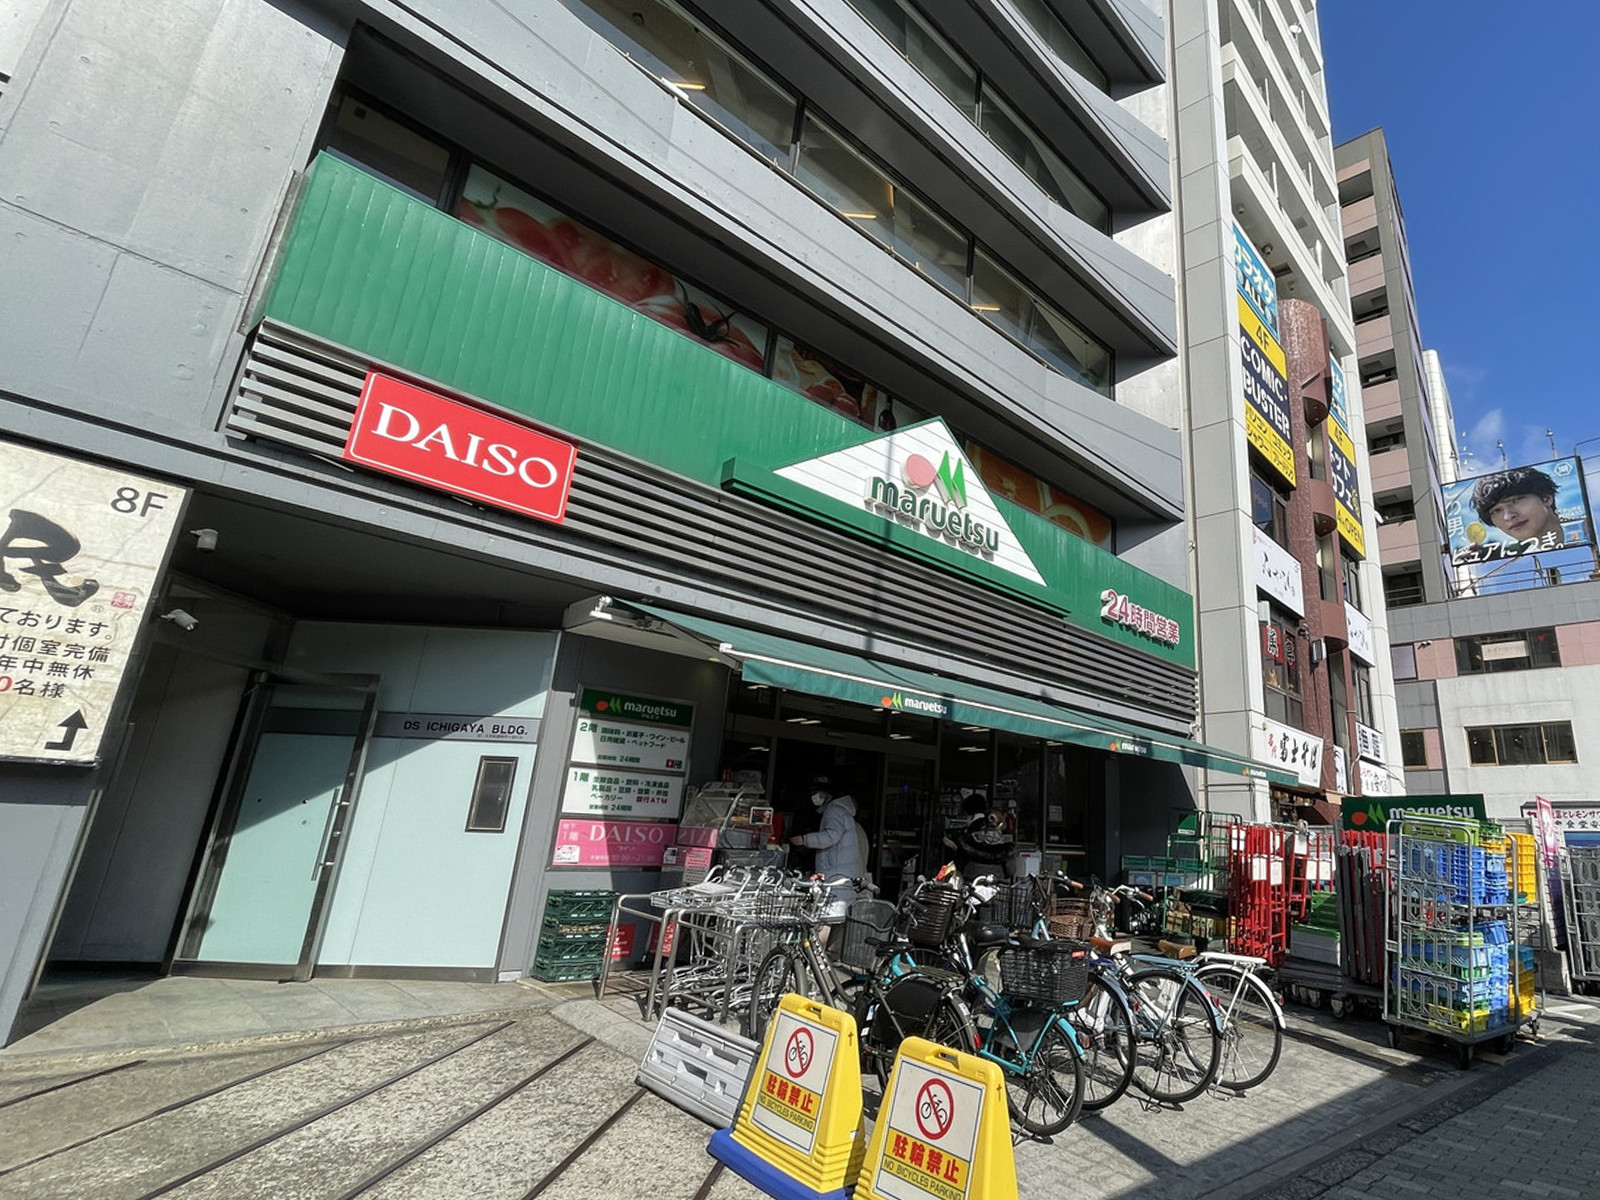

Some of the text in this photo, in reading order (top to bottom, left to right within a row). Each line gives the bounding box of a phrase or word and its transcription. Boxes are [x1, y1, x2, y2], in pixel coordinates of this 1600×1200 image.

[1243, 366, 1291, 440] BUSTER
[370, 402, 558, 488] DAISO
[110, 487, 168, 517] 8F
[868, 475, 1000, 552] maruetsu
[1452, 530, 1564, 564] ピュアにつき。
[0, 607, 112, 640] ております。
[1103, 589, 1179, 644] 24時間営業
[0, 654, 95, 680] 年中無休
[624, 701, 678, 717] maruetsu
[904, 697, 948, 714] maruetsu
[403, 721, 528, 735] DS ICHIGAYA BLDG.
[580, 722, 598, 733] 2階
[573, 771, 590, 783] 1階
[589, 824, 664, 844] DAISO
[766, 1074, 813, 1113] 駐輪禁止
[767, 1098, 789, 1117] BICYCLES
[790, 1111, 814, 1130] PARKING
[892, 1134, 959, 1184] 駐輪禁止
[884, 1158, 962, 1200] NO BICYCLES PARKING
